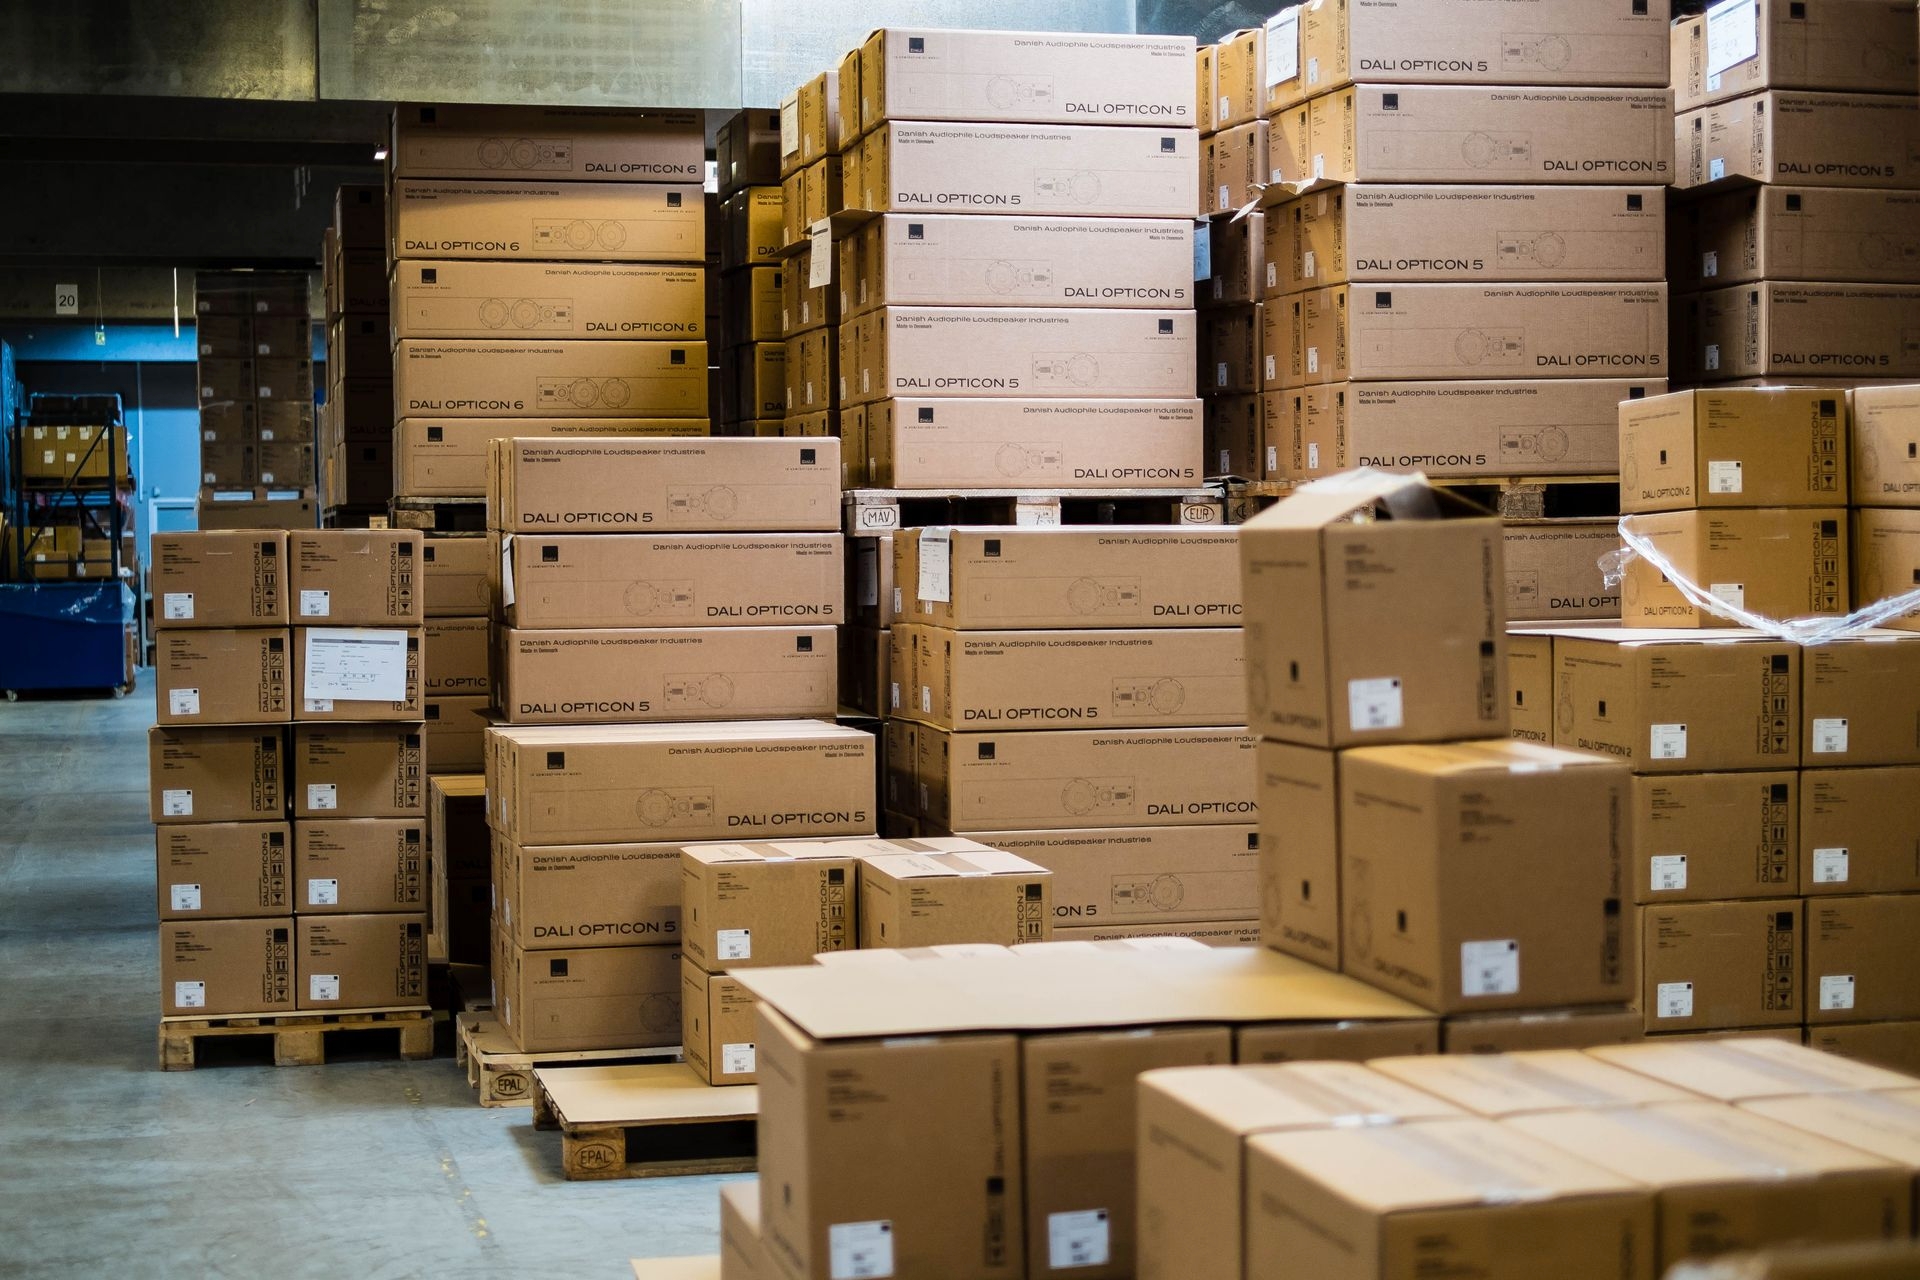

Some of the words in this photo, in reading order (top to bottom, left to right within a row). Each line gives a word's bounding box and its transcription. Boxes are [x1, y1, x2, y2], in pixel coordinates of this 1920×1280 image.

[1360, 59, 1396, 70] DALI
[1400, 60, 1473, 72] OPTICON
[1477, 61, 1488, 72] 5
[1065, 103, 1099, 113] DALI
[1103, 104, 1172, 115] OPTICON
[1176, 105, 1186, 116] 5
[585, 163, 617, 173] DALI
[620, 164, 684, 174] OPTICON
[686, 164, 697, 175] 6
[1543, 160, 1578, 171] DALI
[1582, 160, 1653, 172] OPTICON
[1656, 161, 1667, 172] 5
[1778, 162, 1812, 174] DALI
[1814, 164, 1881, 176] OPTICON
[1884, 166, 1895, 177] 5
[898, 192, 933, 203] DALI
[936, 193, 1007, 205] OPTICON
[1010, 195, 1021, 205] 5
[405, 240, 438, 250] DALI
[441, 241, 506, 251] OPTICON
[509, 242, 520, 252] 6
[1356, 259, 1392, 270] DALI
[1396, 259, 1469, 270] OPTICON
[1472, 259, 1484, 270] 5
[1064, 287, 1098, 298] DALI
[1101, 288, 1170, 298] OPTICON
[1174, 288, 1185, 299] 5
[59, 295, 75, 307] 20
[586, 322, 617, 332] DALI
[620, 322, 684, 332] OPTICON
[687, 323, 698, 332] 6
[1536, 355, 1571, 366] DALI
[1575, 354, 1646, 366] OPTICON
[1649, 354, 1660, 365] 5
[1772, 353, 1806, 365] DALI
[1808, 354, 1876, 365] OPTICON
[1879, 355, 1890, 366] 5
[896, 377, 931, 388] DALI
[934, 378, 1005, 388] OPTICON
[1009, 378, 1019, 389] 5
[1390, 389, 1437, 397] Audiophile
[410, 400, 442, 410] DALI
[445, 400, 510, 410] OPTICON
[513, 400, 524, 410] 6
[1359, 456, 1395, 467] DALI
[1399, 455, 1471, 466] OPTICON
[1475, 454, 1486, 466] 5
[1074, 468, 1108, 479] DALI
[1111, 468, 1180, 479] OPTICON
[1184, 468, 1194, 479] 5
[523, 513, 560, 524] DALI
[563, 512, 638, 523] OPTICON
[642, 512, 653, 523] 5
[869, 511, 889, 523] MAV
[1190, 508, 1208, 520] EUR
[1550, 598, 1585, 609] DALI
[707, 606, 743, 617] DALI
[746, 605, 819, 616] OPTICON
[822, 604, 833, 615] 5
[1153, 605, 1190, 616] DALI
[1194, 604, 1243, 615] OPTIC
[520, 703, 557, 714] DALI
[560, 702, 635, 713] OPTICON
[639, 701, 650, 712] 5
[964, 709, 1002, 720] DALI
[1006, 707, 1082, 720] OPTICON
[1086, 707, 1098, 718] 5
[755, 745, 818, 753] Loudspeaker
[818, 744, 865, 752] Industries
[1147, 804, 1184, 815] DALI
[728, 815, 767, 827] DALI
[771, 812, 850, 825] OPTICON
[854, 811, 866, 823] 5
[532, 856, 568, 864] Danish
[569, 854, 621, 863] Audiophile
[621, 852, 682, 861] Loudspeake
[534, 926, 574, 938] DALI
[578, 922, 659, 936] OPTICON
[664, 921, 676, 933] 5
[498, 1079, 523, 1091] EPAL
[580, 1150, 610, 1164] EPAL
